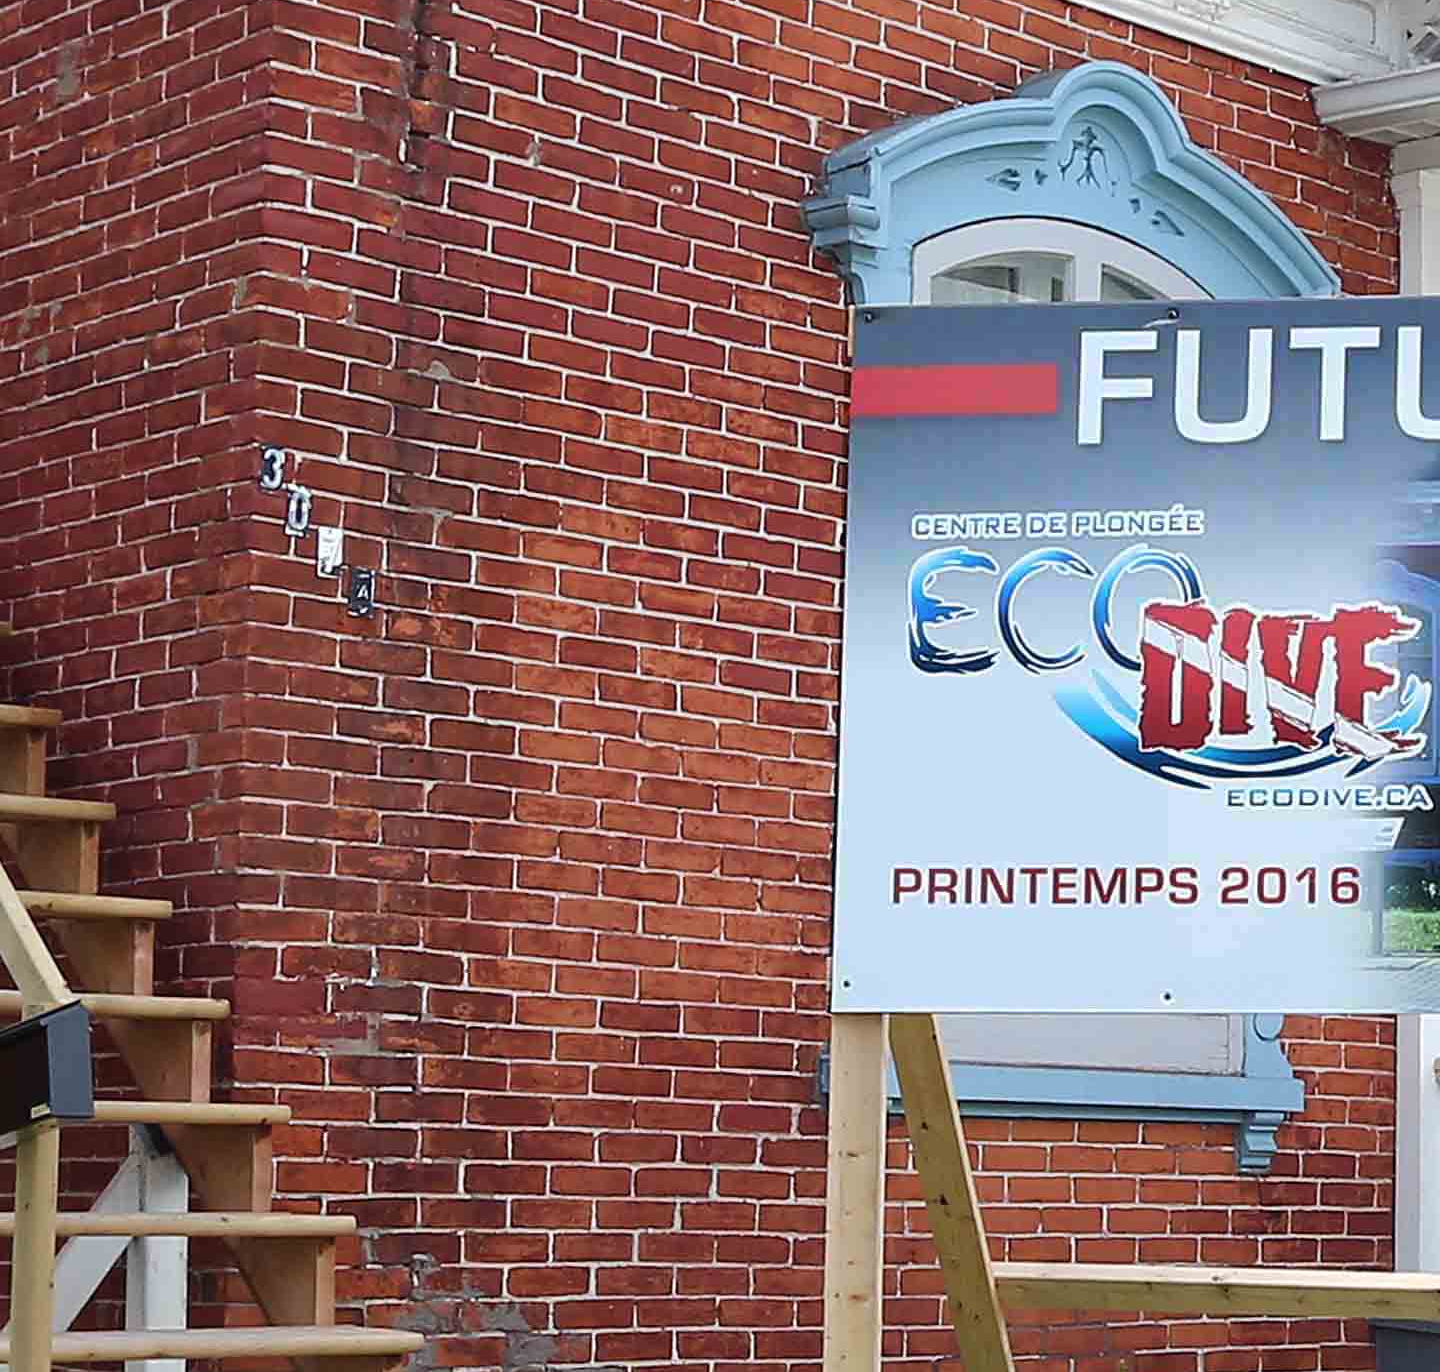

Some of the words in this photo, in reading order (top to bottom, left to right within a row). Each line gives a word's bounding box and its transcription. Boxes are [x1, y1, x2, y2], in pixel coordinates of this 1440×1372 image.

[913, 515, 1019, 537] CENTRE
[1028, 514, 1065, 535] DE
[1073, 505, 1203, 534] PLONGÉE
[1226, 786, 1432, 809] ECODIVE.CA
[892, 866, 1199, 905] PRINTEMPS
[1220, 866, 1361, 905] 2016
